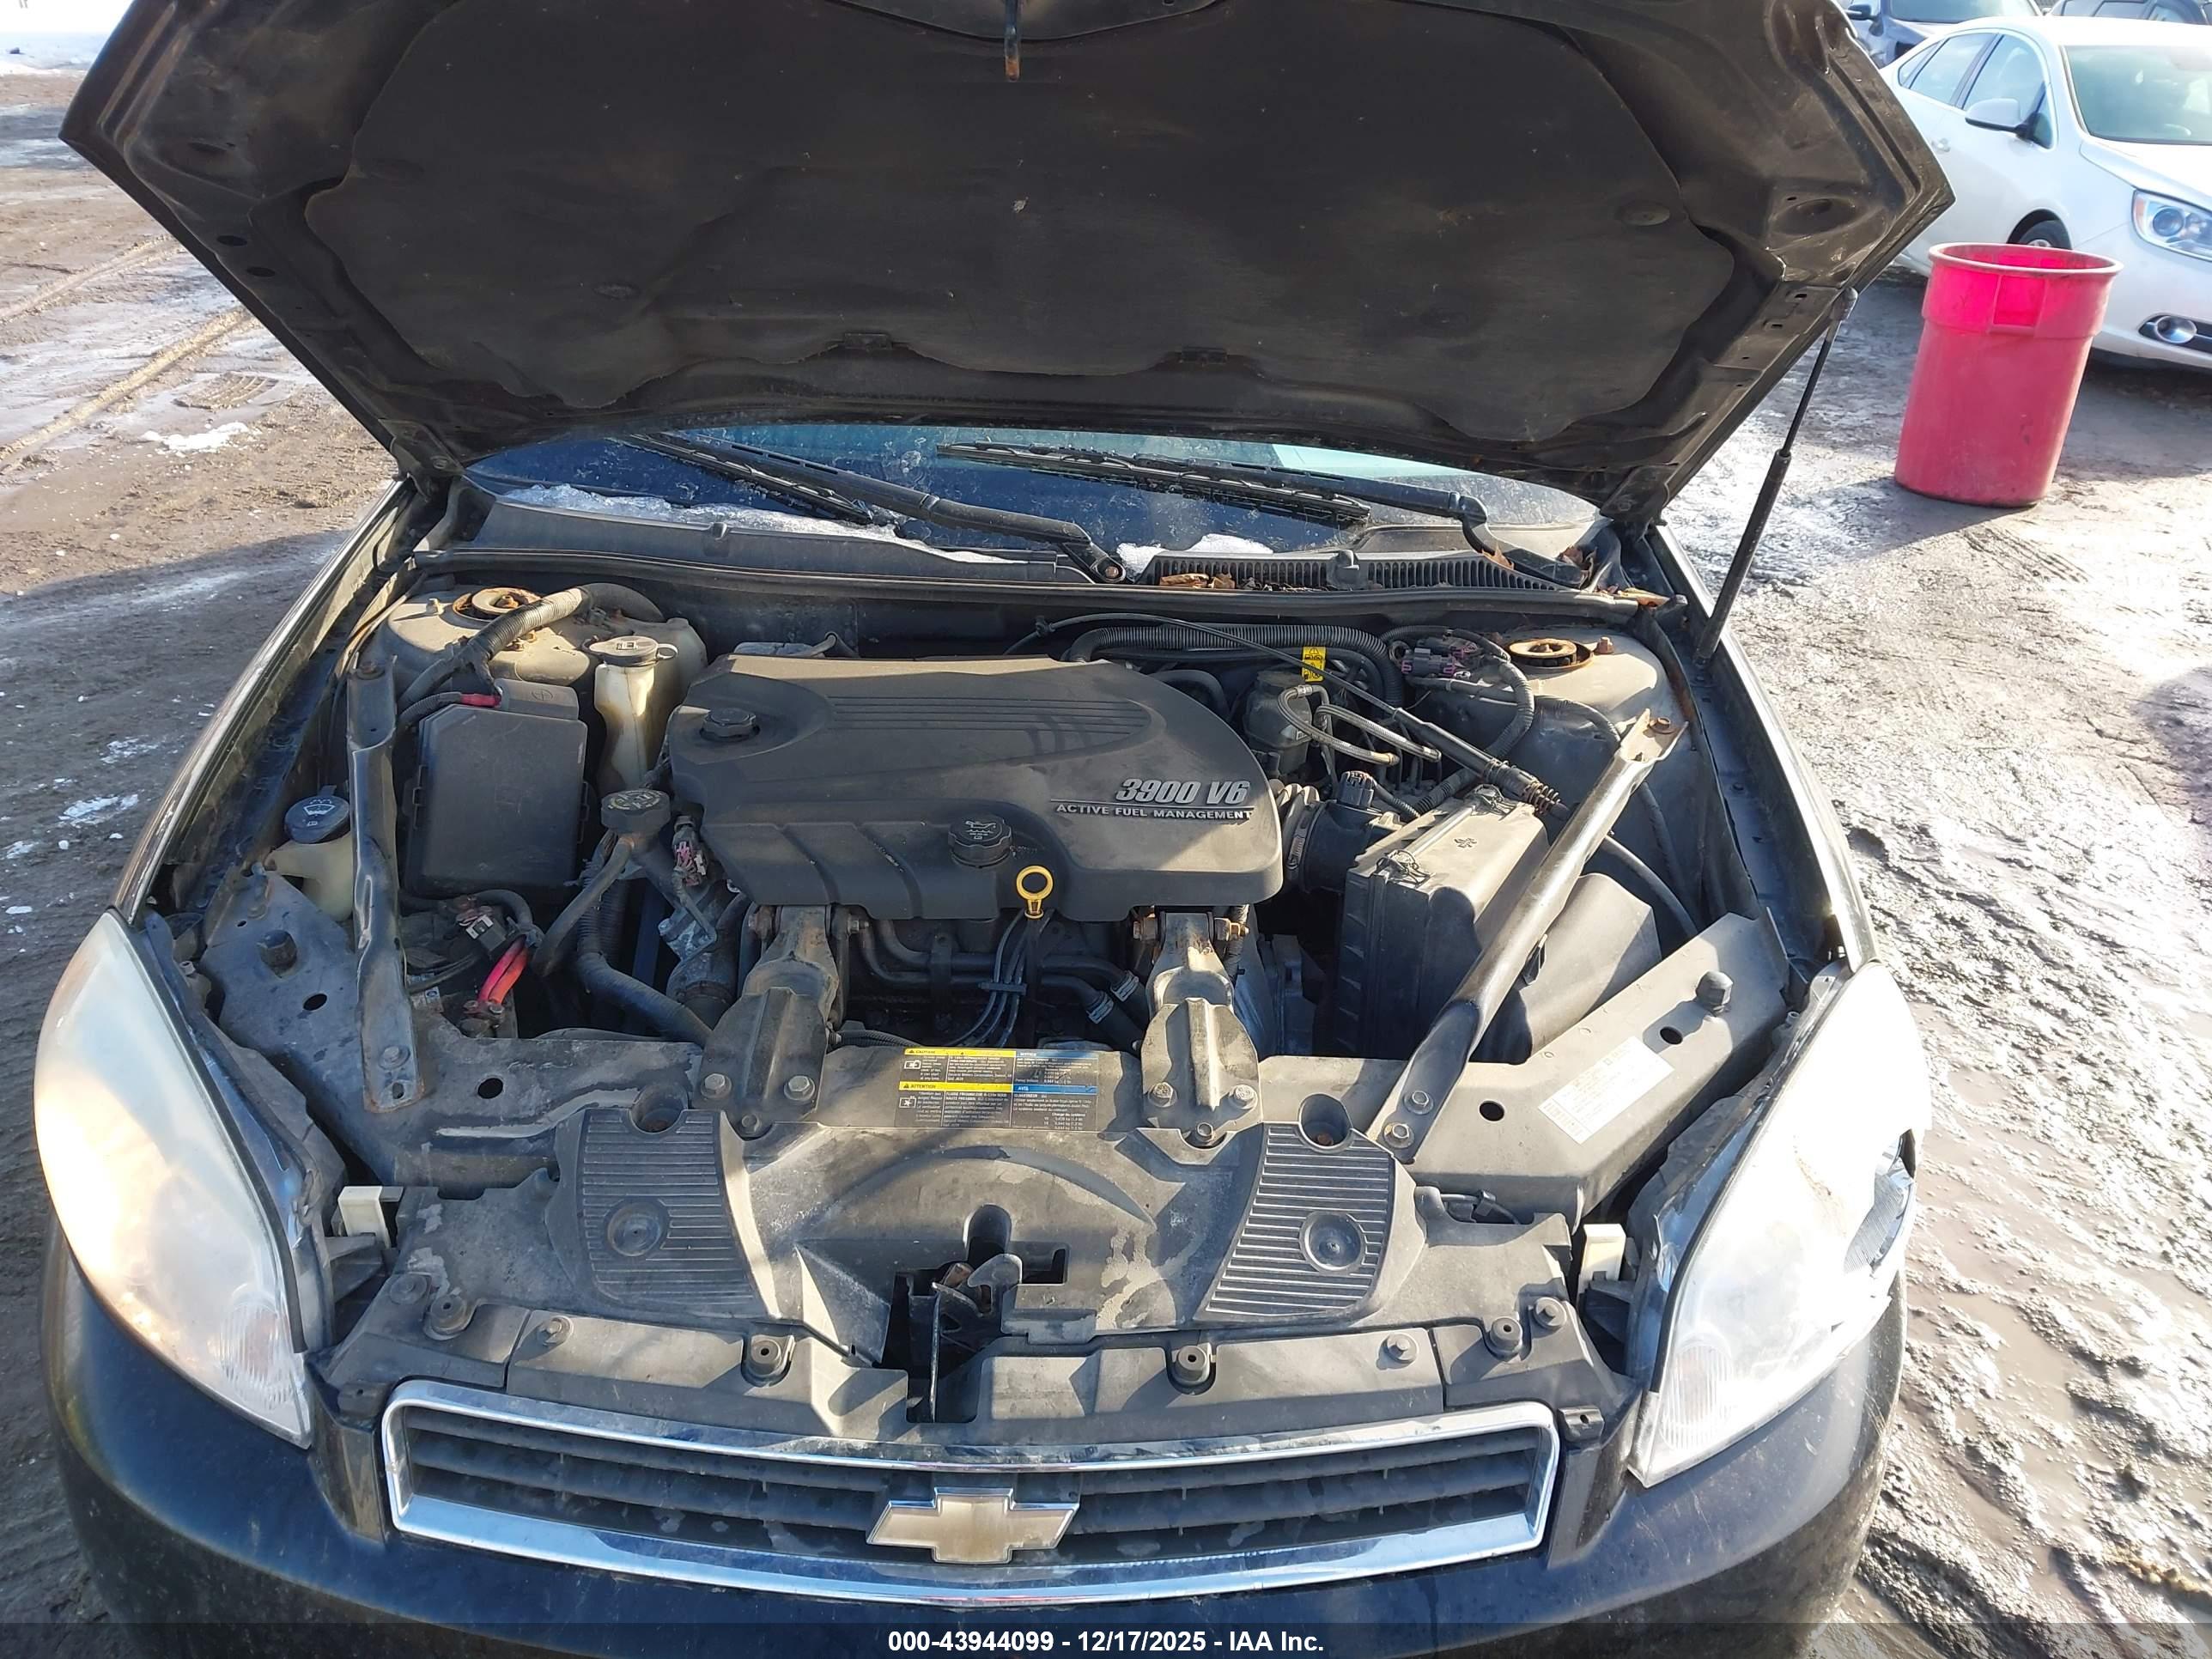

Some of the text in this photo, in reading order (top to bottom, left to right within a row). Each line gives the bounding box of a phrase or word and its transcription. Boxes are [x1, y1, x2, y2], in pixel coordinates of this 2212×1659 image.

[1115, 778, 1250, 805] 3900 V6
[1057, 804, 1252, 819] ACTIVE FUEL MANAGEMENT
